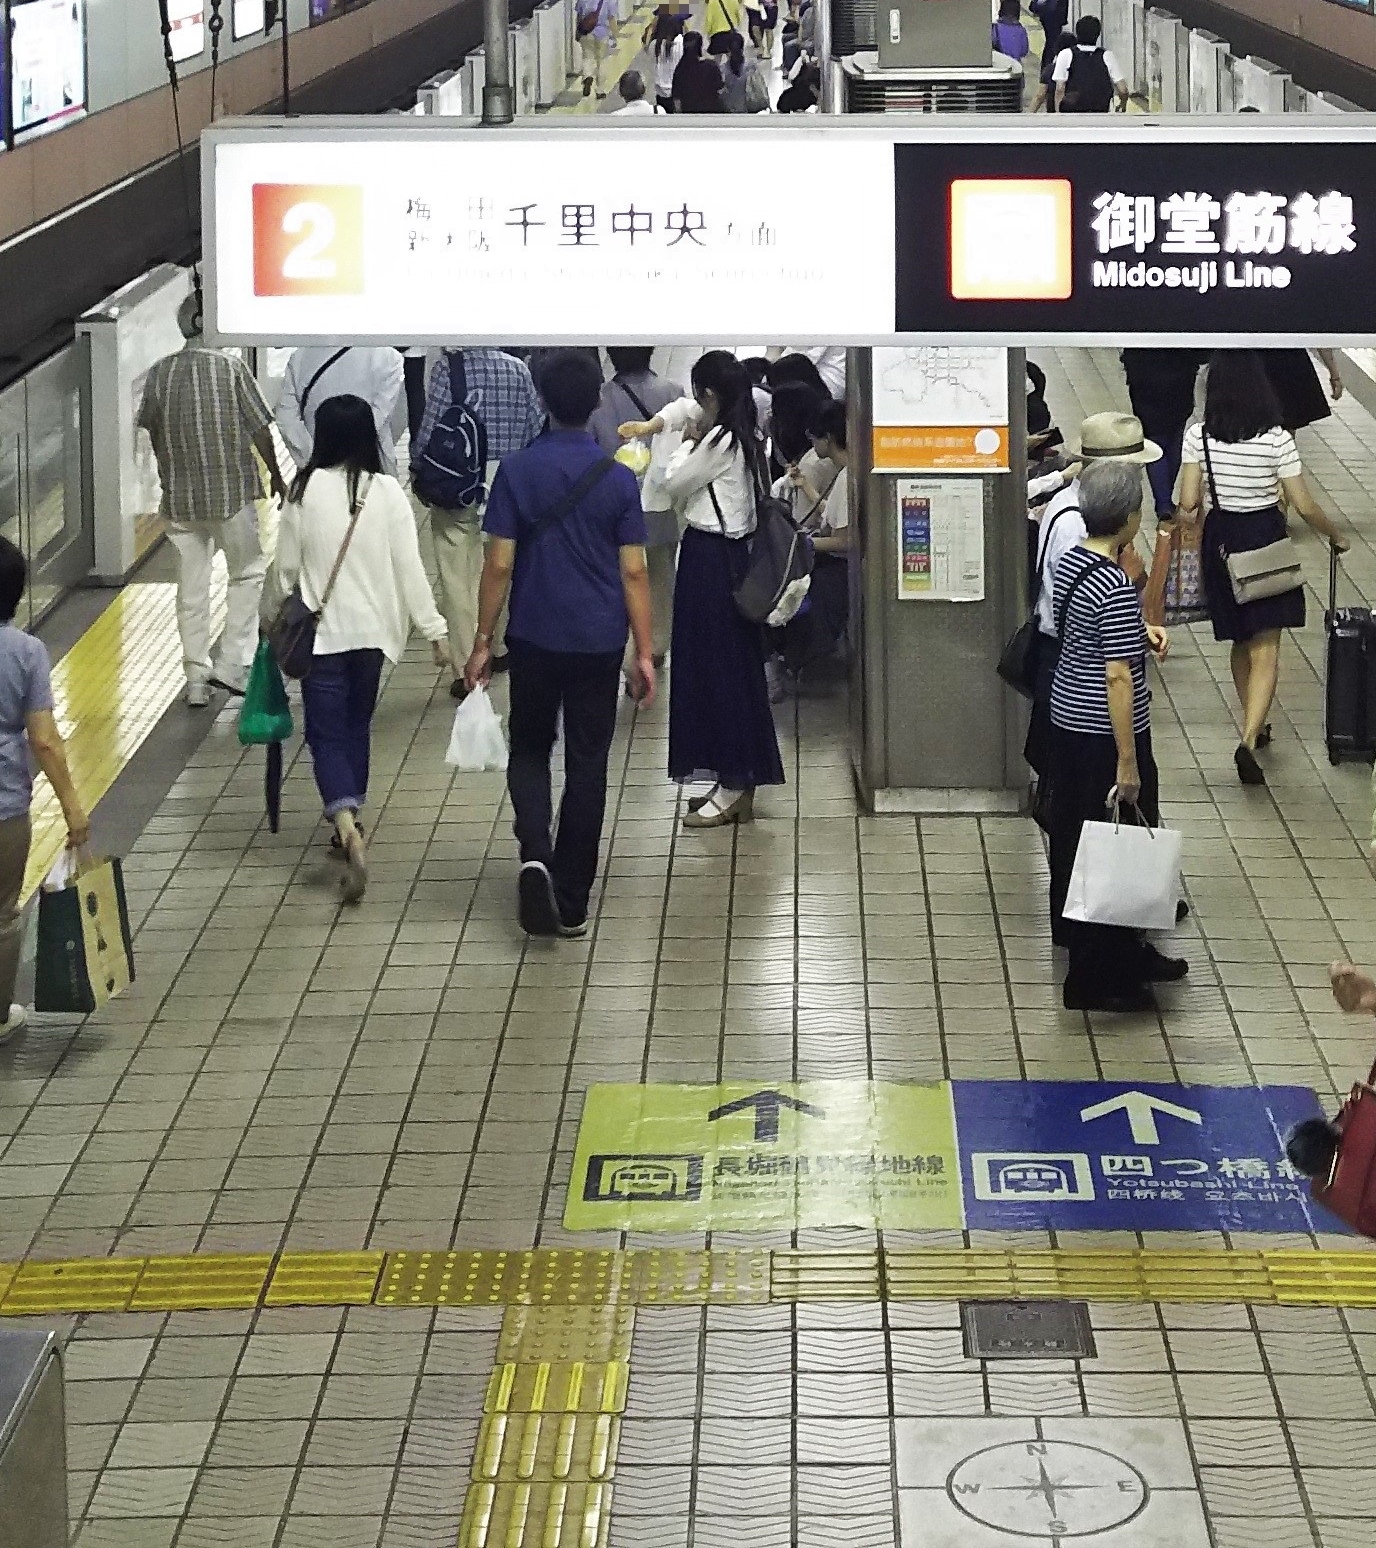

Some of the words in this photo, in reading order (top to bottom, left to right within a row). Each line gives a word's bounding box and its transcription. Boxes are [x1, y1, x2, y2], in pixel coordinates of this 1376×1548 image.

[504, 203, 709, 247] 千里中央
[1091, 191, 1357, 254] 御堂筋線
[282, 202, 337, 278] 2
[1093, 260, 1218, 294] Midosuji
[1225, 260, 1292, 289] Line
[1106, 1177, 1238, 1190] Yotsubashi
[1026, 1443, 1048, 1456] N
[954, 1482, 982, 1495] W
[1117, 1479, 1138, 1494] E
[1047, 1519, 1069, 1534] S
